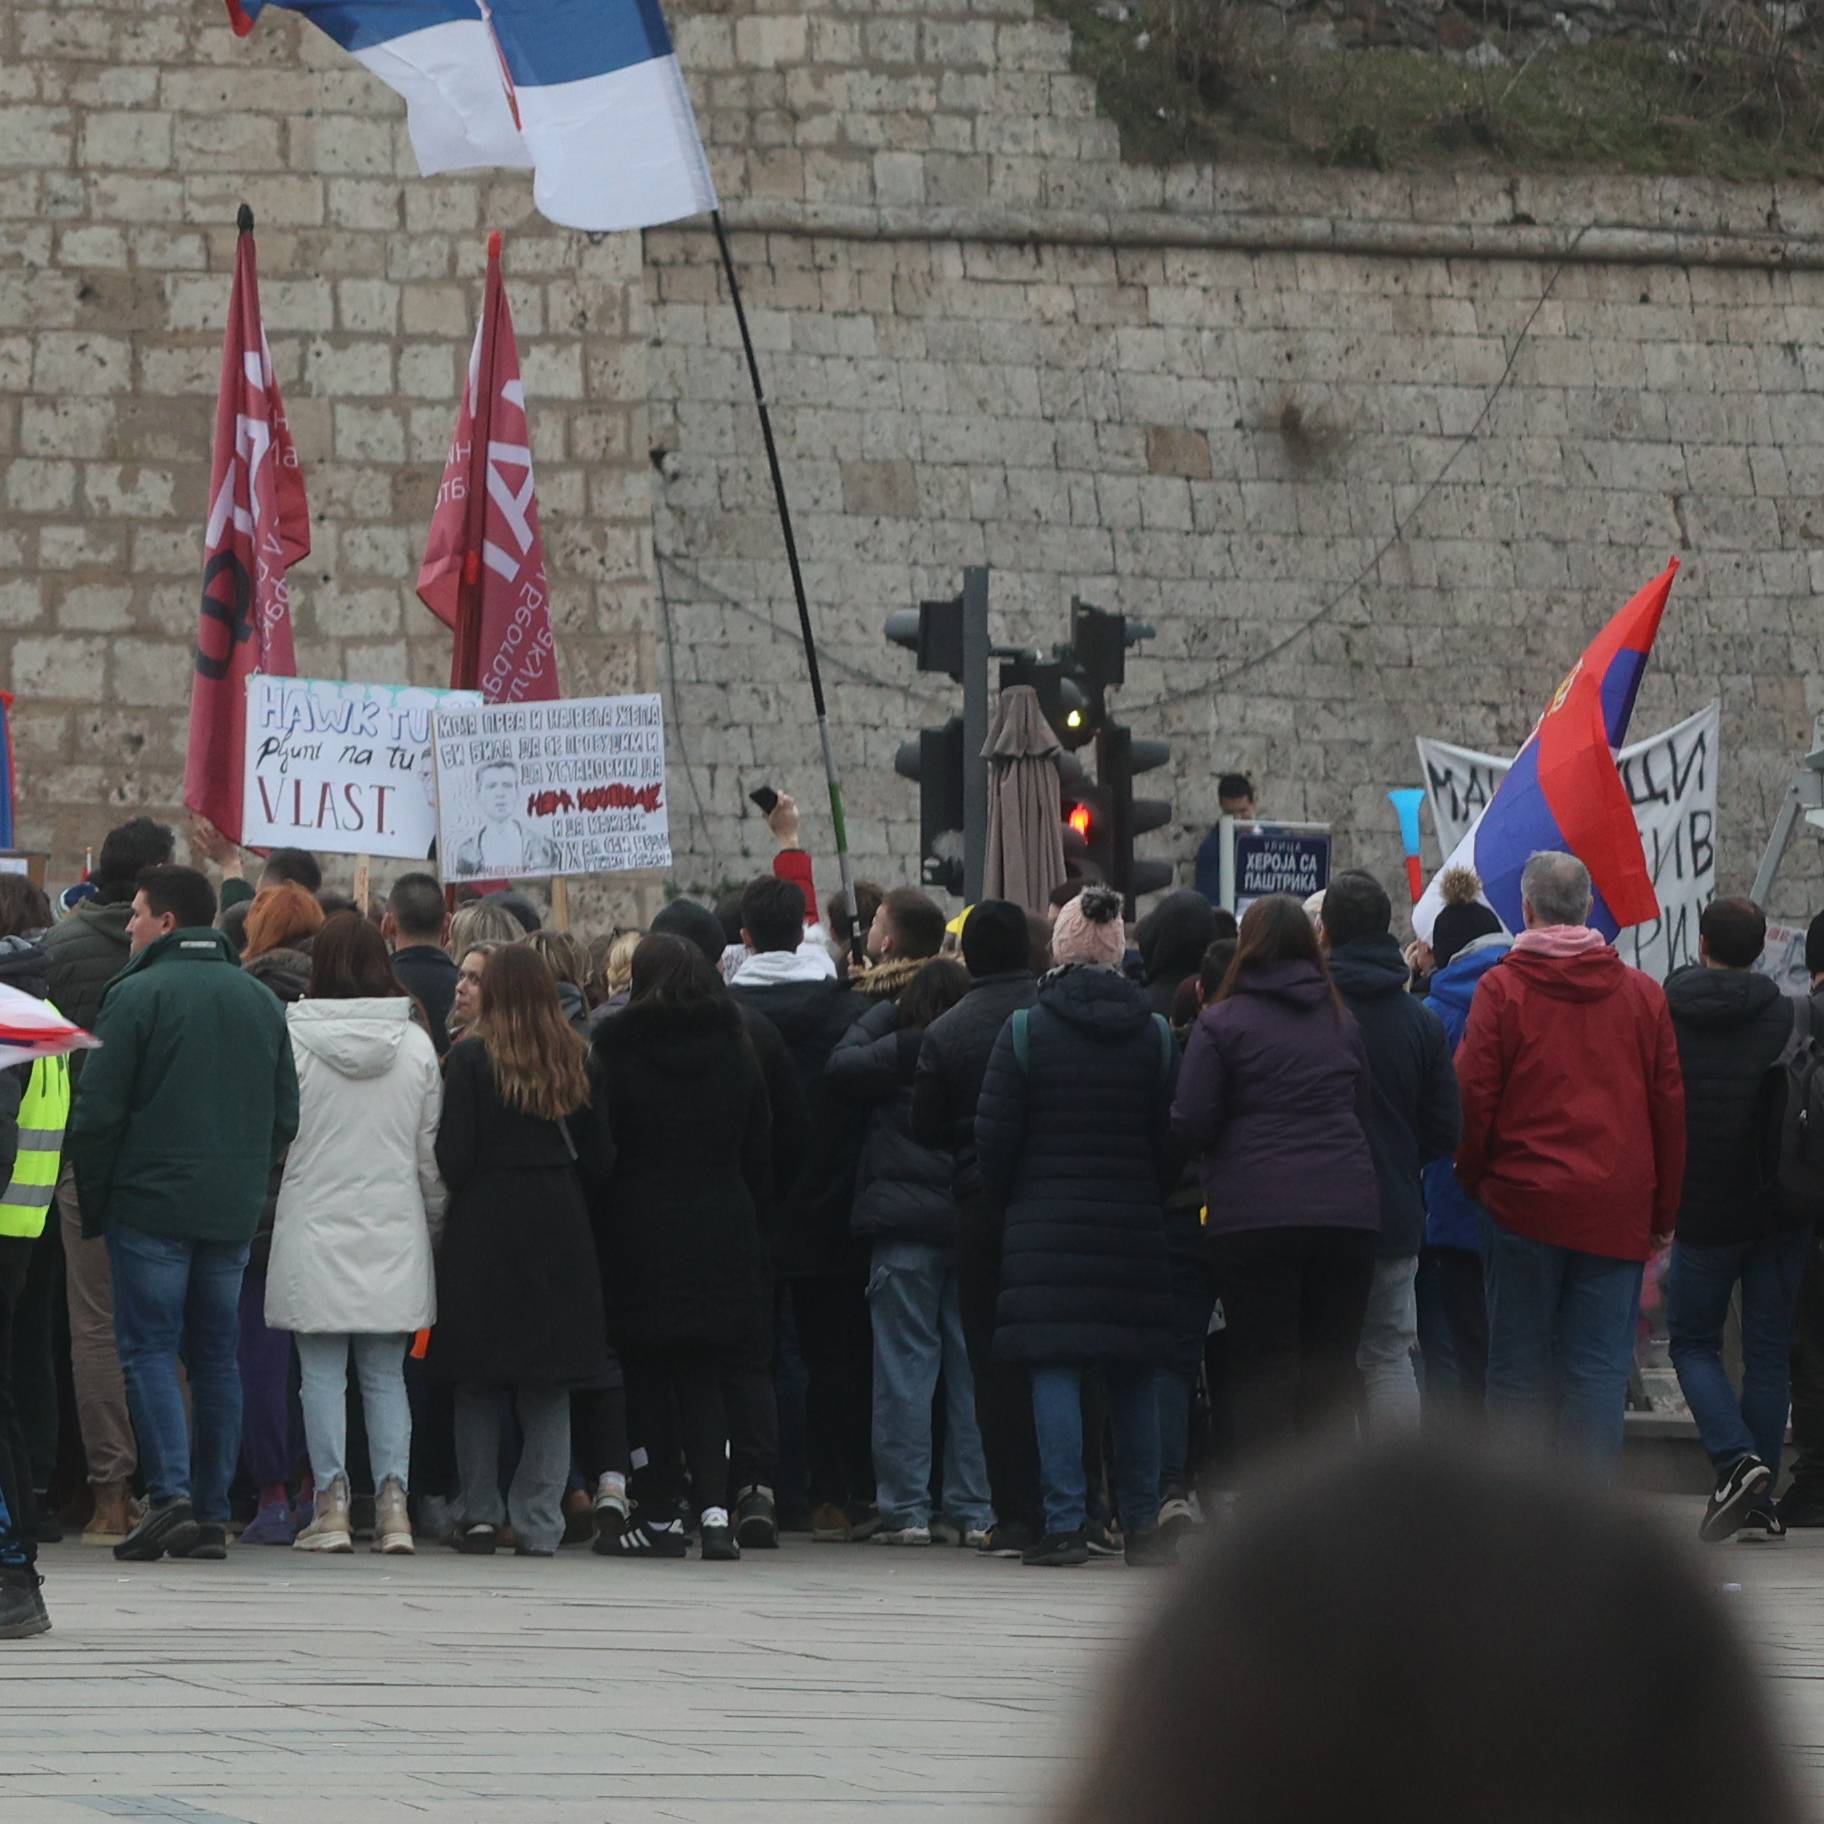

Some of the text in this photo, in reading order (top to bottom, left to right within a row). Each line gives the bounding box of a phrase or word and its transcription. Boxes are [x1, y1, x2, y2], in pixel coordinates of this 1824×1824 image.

[261, 684, 381, 738] HAWK
[482, 711, 525, 734] ПРВА
[530, 709, 544, 729] И
[338, 744, 373, 765] na
[386, 746, 416, 771] tu
[440, 743, 466, 769] БИ
[470, 738, 513, 764] БИЛА
[645, 731, 659, 753] И
[257, 776, 396, 836] VLAST.
[1245, 852, 1318, 873] ХЕРОЈА СА
[1244, 872, 1317, 892] ПАШТРИКА
